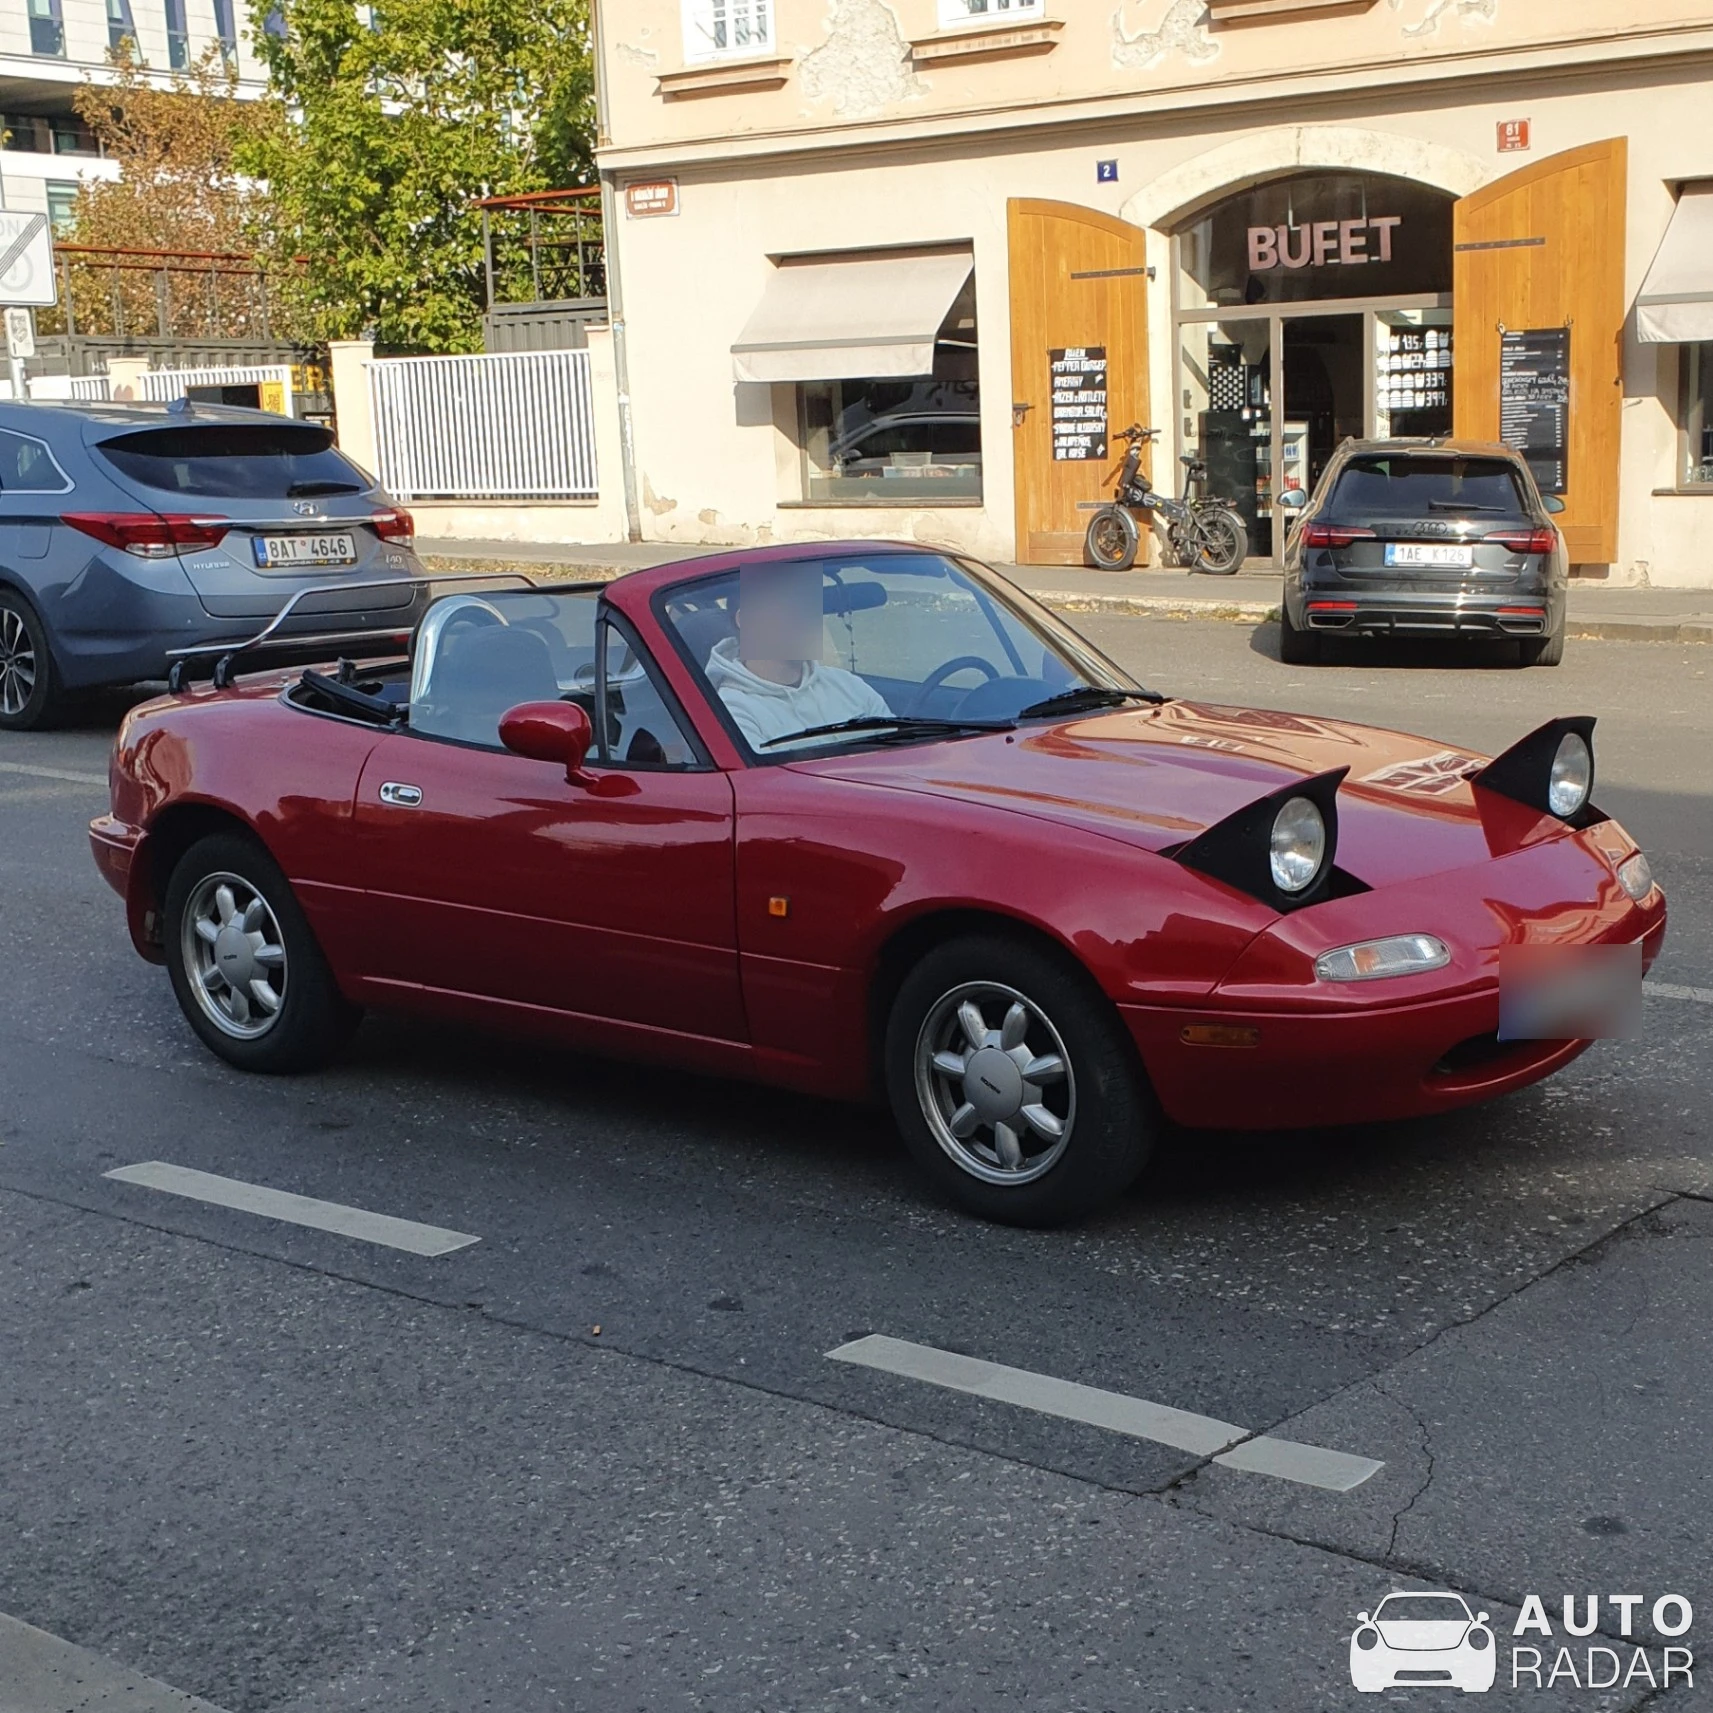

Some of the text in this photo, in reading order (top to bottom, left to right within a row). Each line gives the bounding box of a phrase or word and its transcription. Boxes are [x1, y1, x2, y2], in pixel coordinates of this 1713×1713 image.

[1506, 122, 1519, 136] 81
[1103, 164, 1111, 178] 2
[1247, 216, 1402, 271] BUFET
[270, 539, 298, 559] 8AT
[311, 537, 347, 557] 4646
[1400, 547, 1422, 561] 1AE
[1432, 548, 1465, 562] K126
